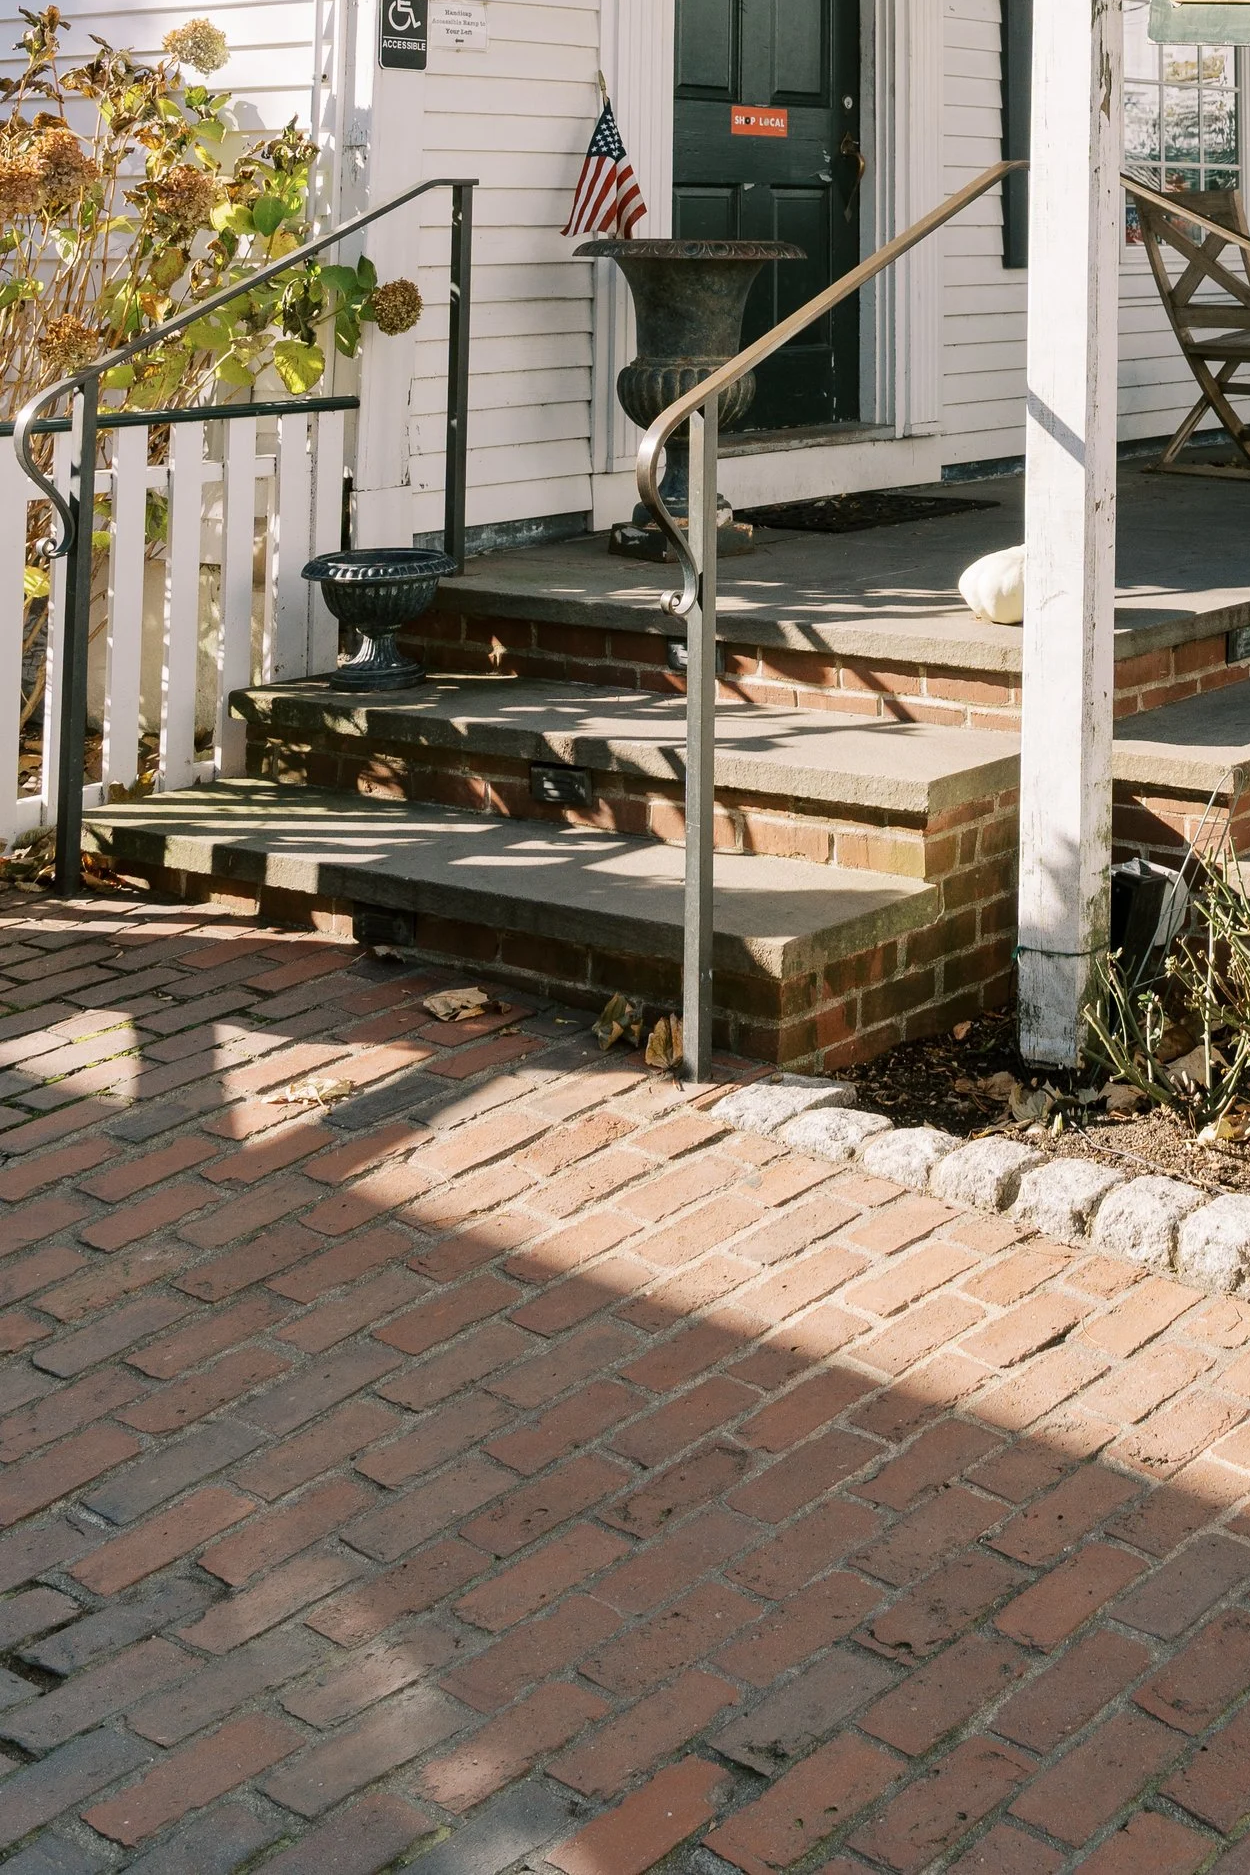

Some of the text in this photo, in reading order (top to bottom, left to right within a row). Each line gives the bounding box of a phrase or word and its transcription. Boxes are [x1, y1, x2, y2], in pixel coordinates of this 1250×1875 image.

[445, 9, 472, 18] Handicap
[382, 39, 426, 51] ACCESSIBLE
[734, 115, 785, 128] SHOP LOCAL
